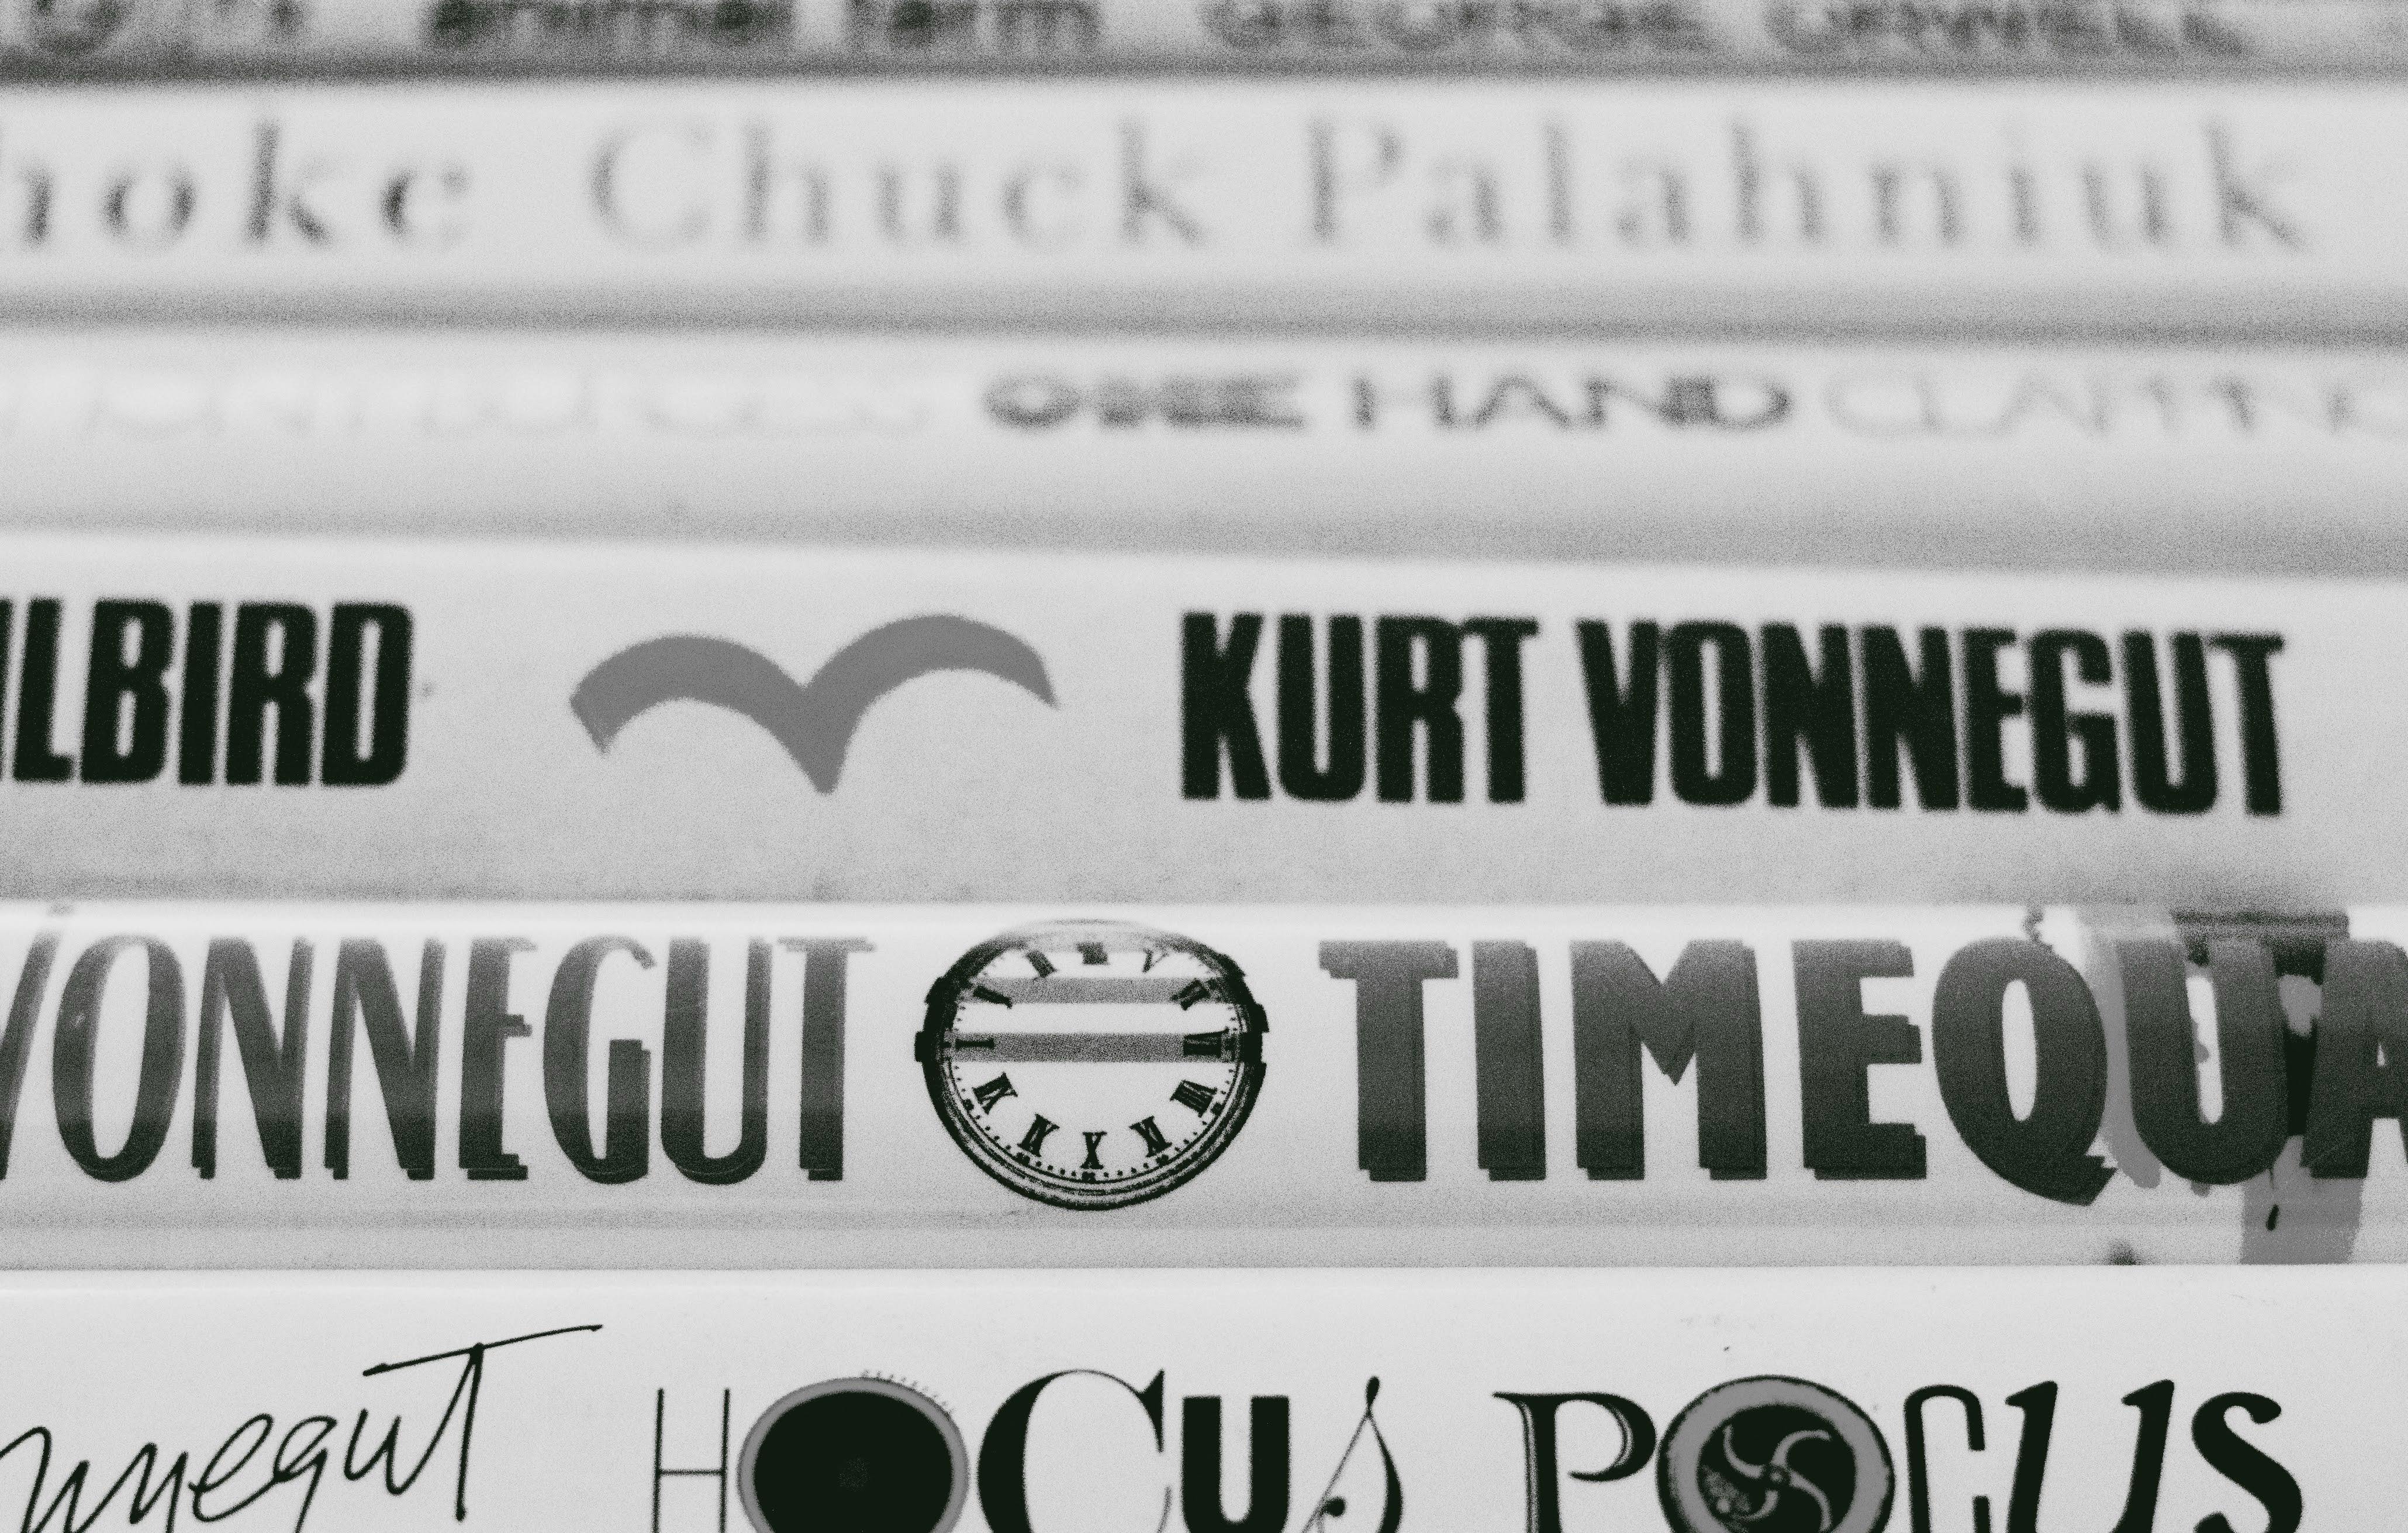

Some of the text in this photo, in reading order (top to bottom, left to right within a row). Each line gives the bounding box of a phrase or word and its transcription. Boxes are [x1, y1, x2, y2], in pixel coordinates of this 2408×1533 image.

[583, 110, 1210, 255] Chuck
[1304, 110, 2312, 256] Palahniuk
[1348, 372, 1796, 436] HAND
[1179, 610, 2287, 818] KURT VONNEGUT
